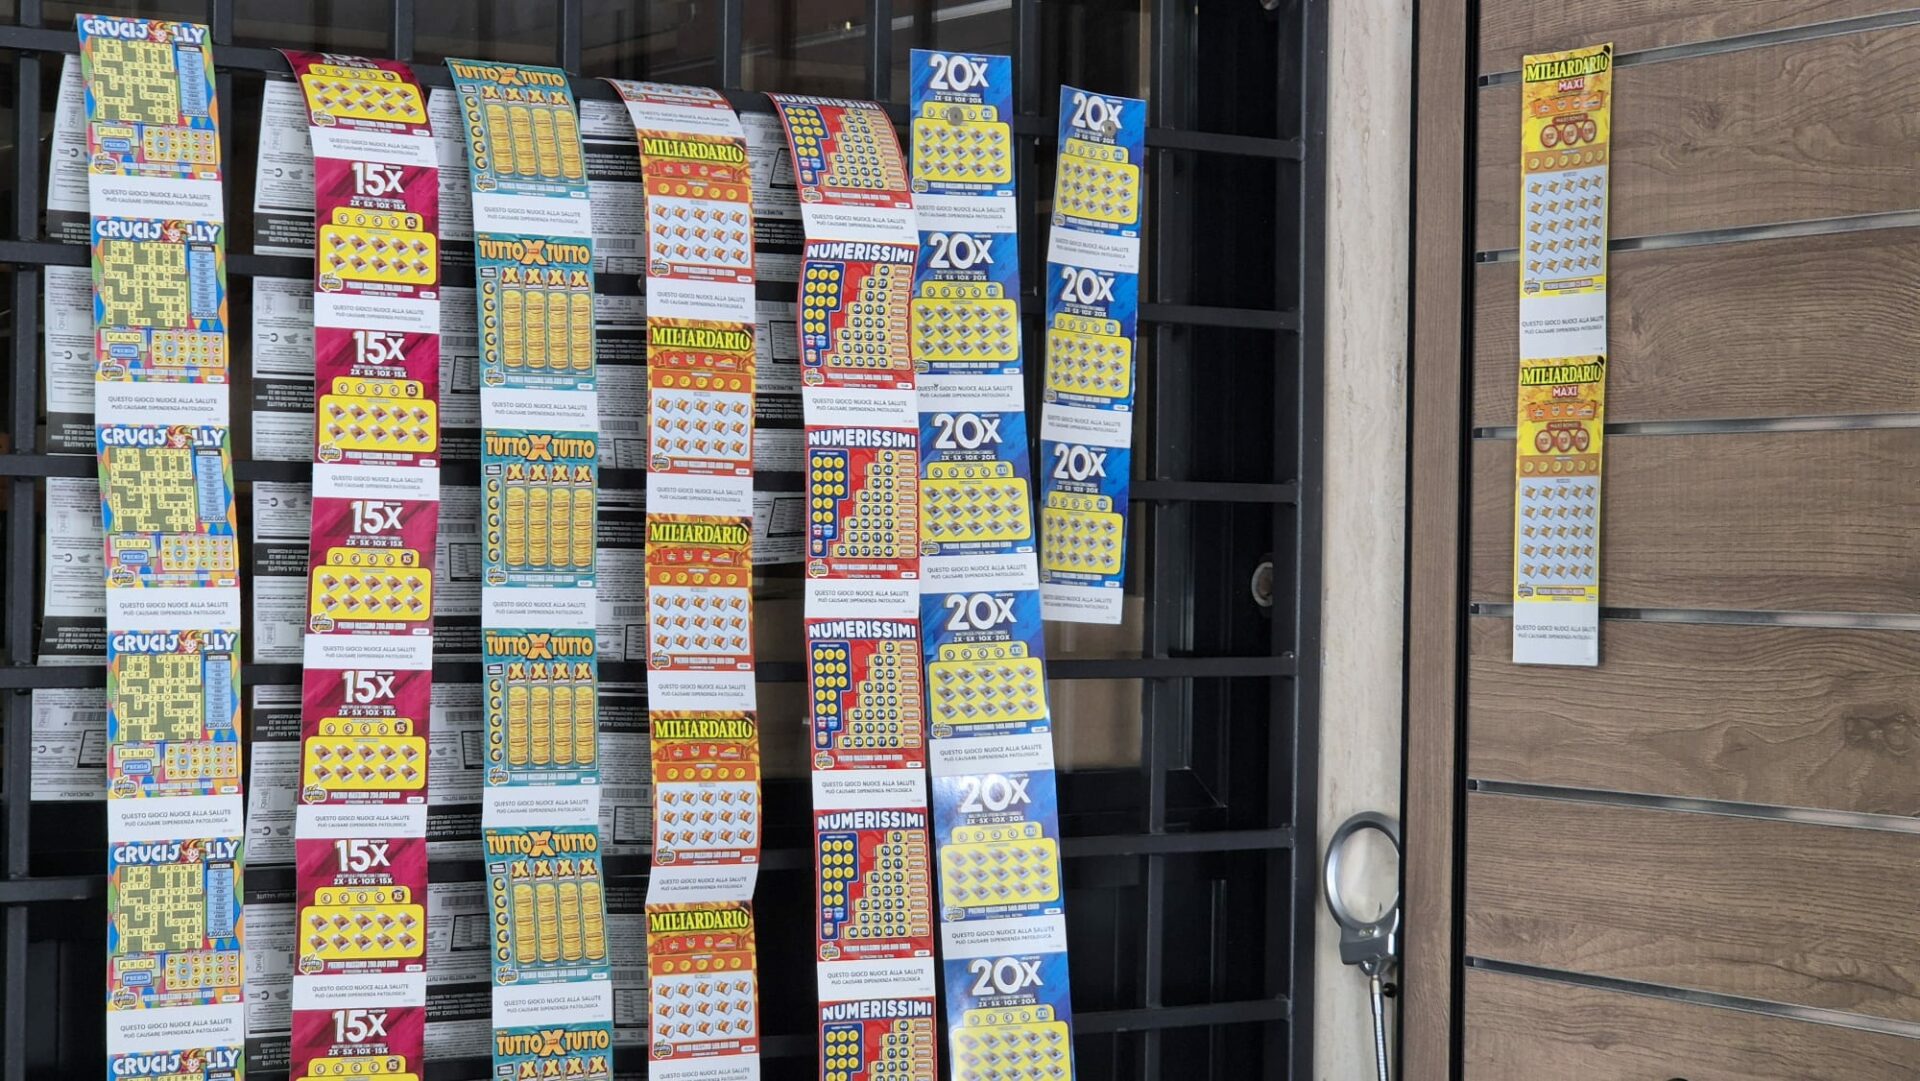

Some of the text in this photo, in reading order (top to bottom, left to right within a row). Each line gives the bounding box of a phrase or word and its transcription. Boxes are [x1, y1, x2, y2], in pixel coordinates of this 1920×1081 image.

[929, 54, 989, 91] 20X
[1526, 54, 1608, 82] MILIARDARIO
[1558, 78, 1584, 92] MAXI
[773, 95, 879, 110] NUMERISSIMI
[1072, 93, 1123, 131] 20X
[643, 138, 744, 163] MILIARDARIO
[352, 162, 404, 196] 15X
[807, 243, 914, 263] NUMERISSIMI
[928, 233, 994, 269] 20X
[1061, 266, 1115, 304] 20X
[353, 331, 405, 364] 15X
[651, 326, 750, 350] MILIARDARIO
[1522, 364, 1601, 385] MILIARDARIO
[1553, 386, 1578, 397] MAXI
[809, 429, 915, 448] NUMERISSIMI
[934, 413, 1002, 449] 20X
[1054, 443, 1107, 481] 20X
[352, 501, 404, 534] 15X
[651, 523, 747, 545] MILIARDARIO
[946, 593, 1017, 630] 20X
[809, 621, 915, 639] NUMERISSIMI
[342, 671, 395, 704] 15X
[655, 720, 754, 739] MILIARDARIO
[960, 773, 1031, 814] 20X
[817, 811, 924, 830] NUMERISSIMI
[335, 839, 390, 872] 15X
[650, 910, 749, 932] MILIARDARIO
[969, 957, 1044, 996] 20X
[333, 1009, 388, 1043] 15X
[822, 1000, 931, 1022] NUMERISSIMI
